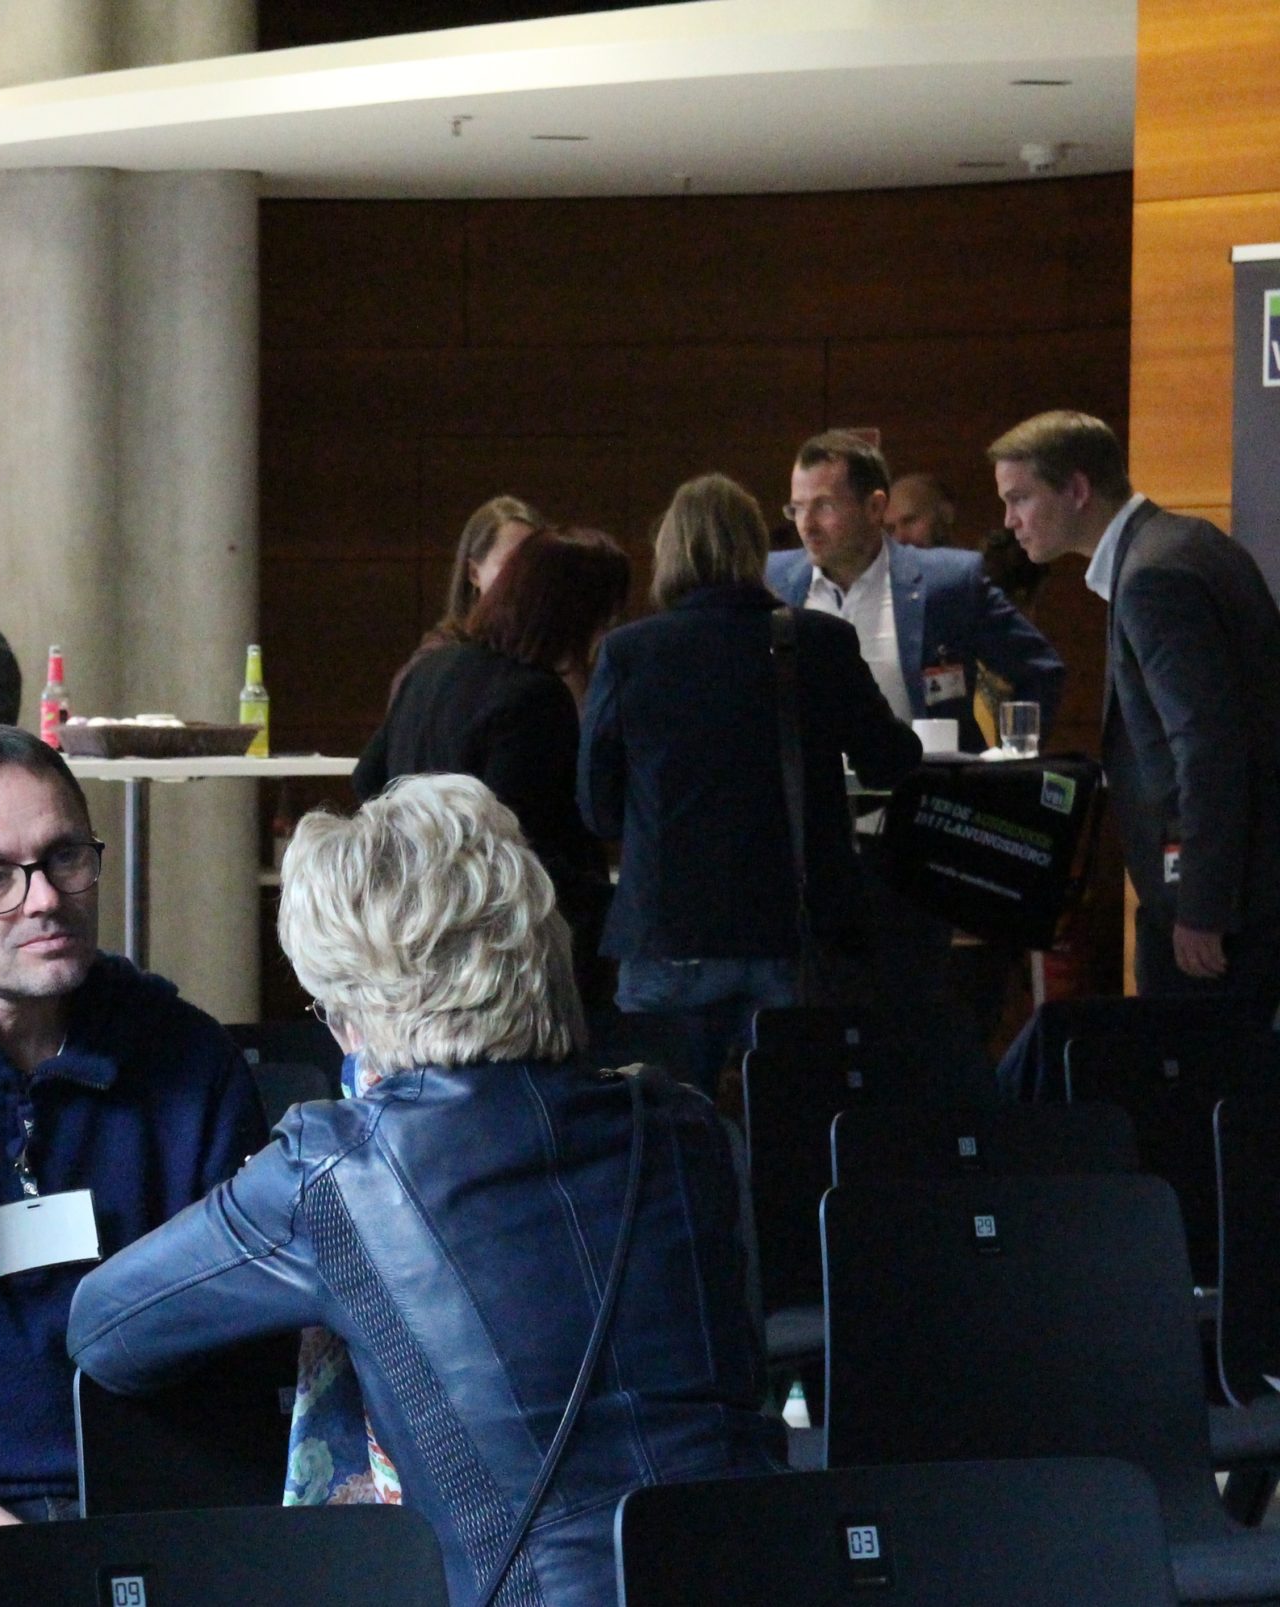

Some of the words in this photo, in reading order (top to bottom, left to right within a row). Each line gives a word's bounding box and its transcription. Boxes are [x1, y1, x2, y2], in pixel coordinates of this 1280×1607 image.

[976, 1218, 994, 1234] 29
[850, 1530, 875, 1554] 03
[114, 1581, 141, 1607] 09
